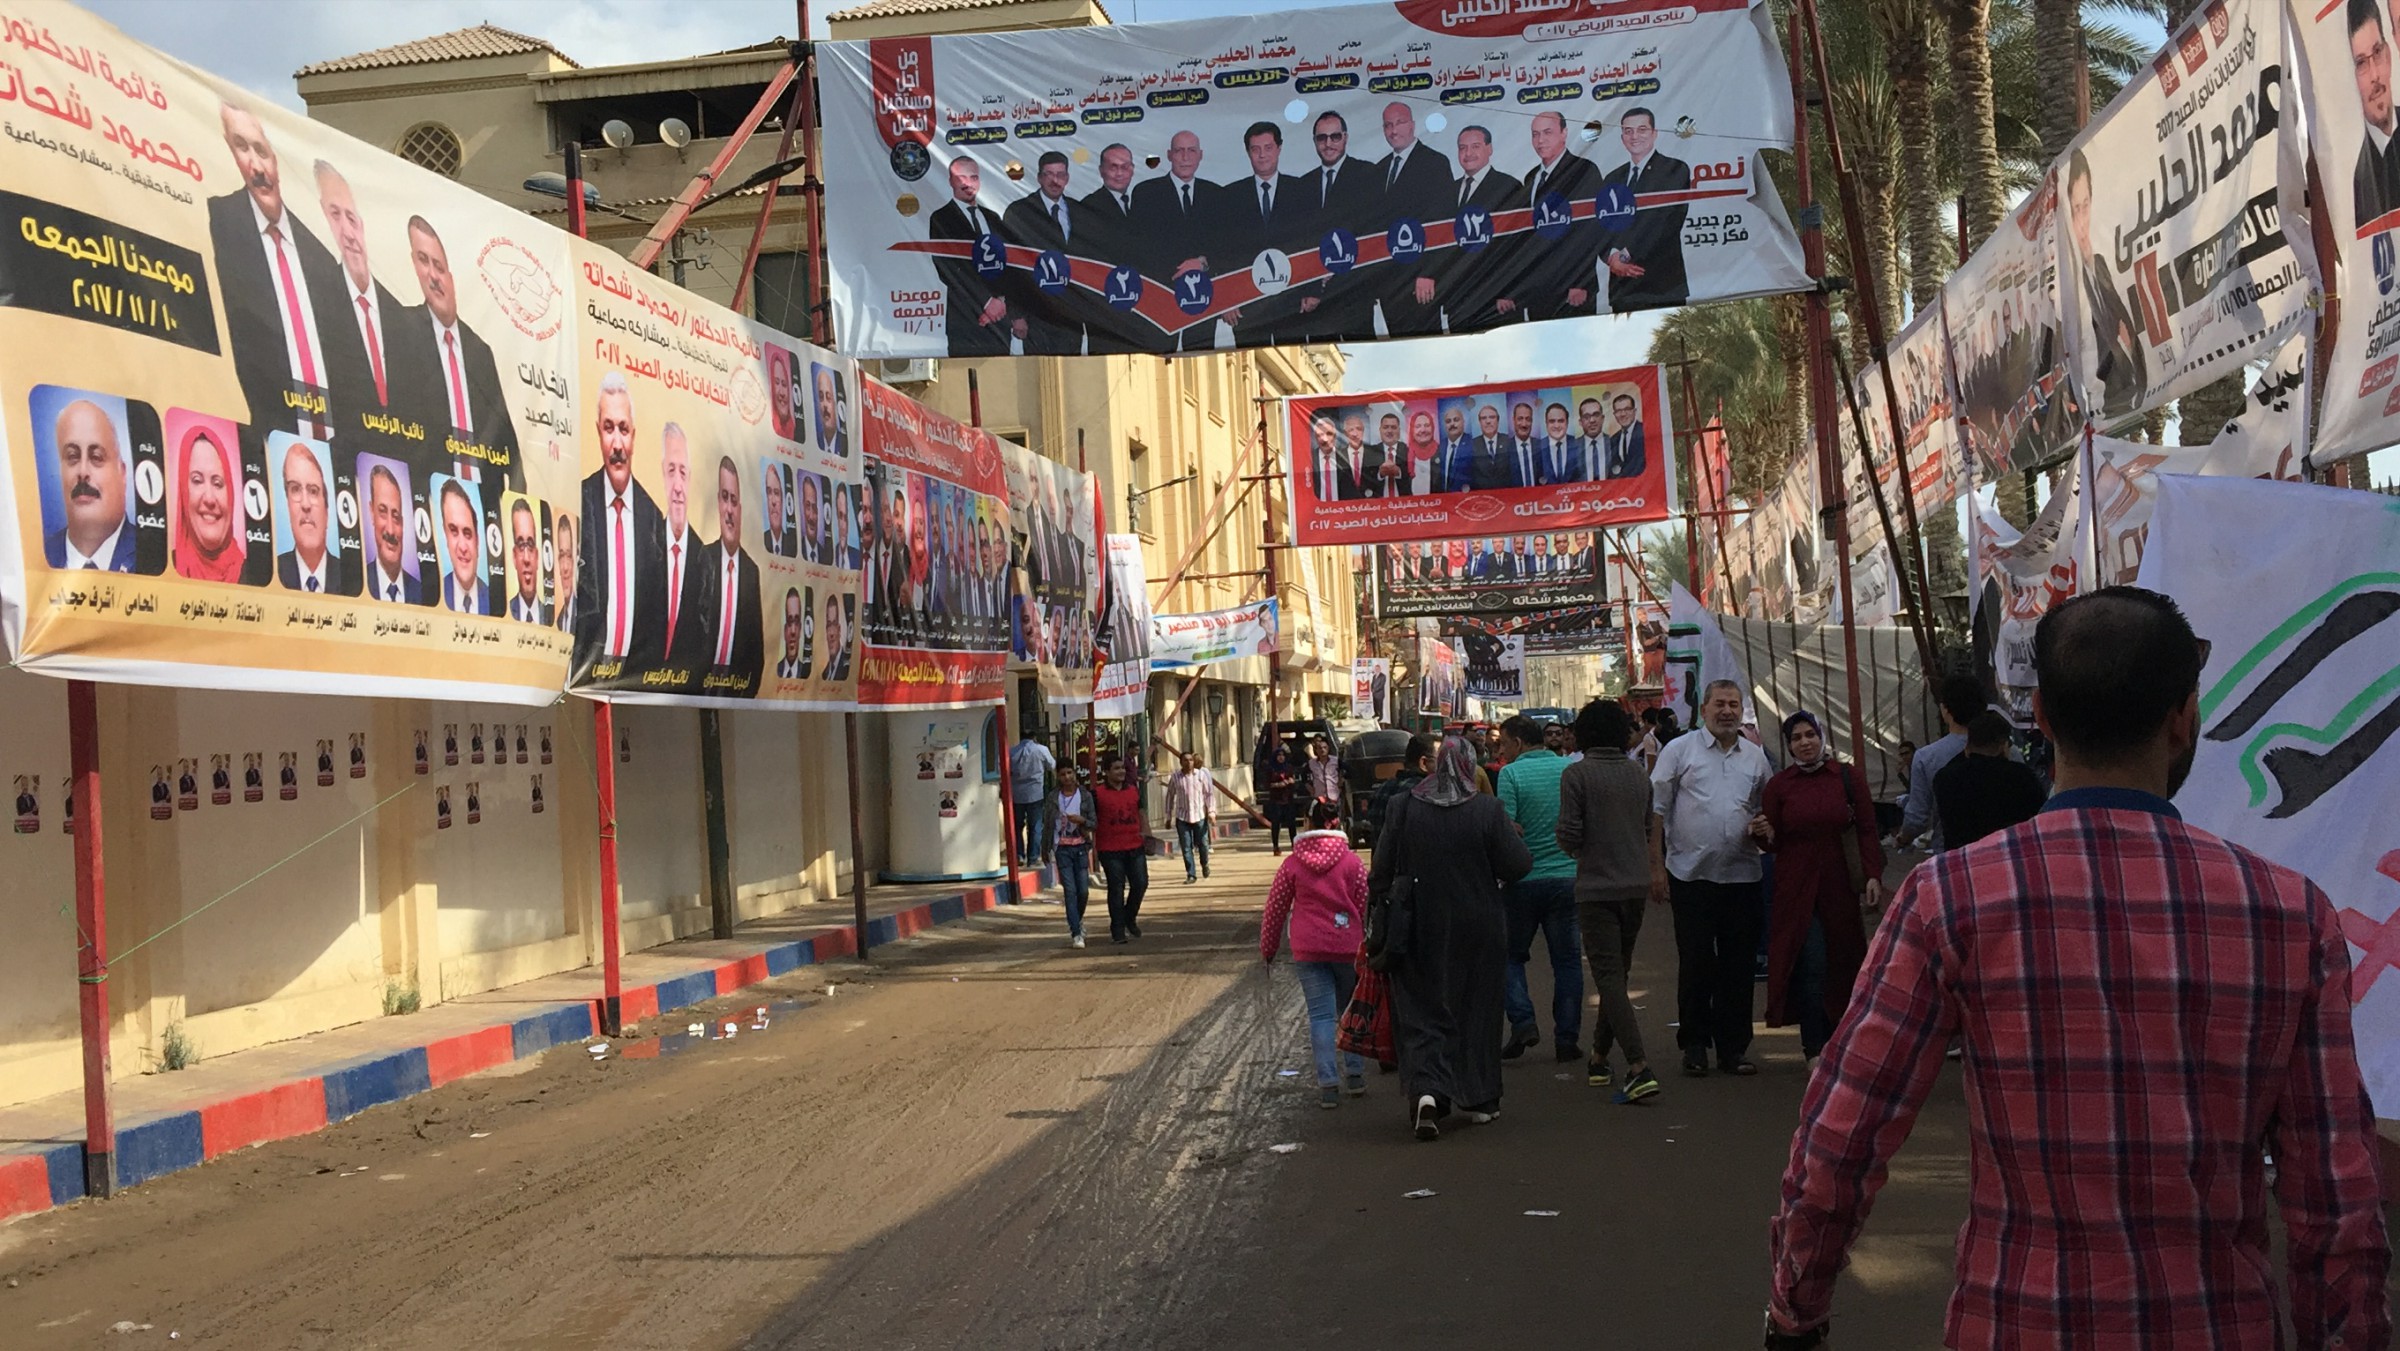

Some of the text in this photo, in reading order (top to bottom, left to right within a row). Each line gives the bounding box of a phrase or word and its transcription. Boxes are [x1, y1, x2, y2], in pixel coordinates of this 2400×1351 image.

[1537, 14, 1651, 36] الصيد ٢٠١٧
[898, 48, 918, 71] من
[1205, 44, 1296, 69] محمد الحليبى
[1290, 54, 1363, 77] محمد السبكى
[1366, 52, 1399, 78] نسيم
[1631, 53, 1662, 76] أحمد
[100, 51, 168, 111] قائمة
[896, 66, 919, 93] أجل
[1222, 69, 1282, 86] الرئيس
[1487, 62, 1512, 83] ياسر
[1551, 65, 1586, 80] مسعد
[1302, 77, 1333, 92] الرئيس
[1369, 76, 1430, 92] عضو فوق السن
[1520, 85, 1582, 103] عضو فوق السن
[1595, 81, 1658, 99] عضو تحت السن
[2197, 73, 2216, 110] نادى
[878, 91, 932, 115] مستقبل
[1152, 92, 1186, 106] الصندوق
[1444, 88, 1502, 104] عضو فوق السن
[976, 108, 1006, 121] محمد
[1043, 99, 1075, 119] مصطفى
[1083, 108, 1142, 124] عضو فوق السن
[2174, 89, 2198, 129] الصيد
[0, 60, 204, 182] محمود شحات
[892, 110, 928, 137] أفضل
[1016, 122, 1075, 137] عضو فوق السن
[2155, 110, 2176, 143] 2017
[4, 121, 58, 153] جماعية
[946, 131, 968, 143] السن
[988, 130, 1007, 141] عضو
[122, 163, 165, 194] حقيقية
[1690, 156, 1746, 189] نعم
[164, 180, 194, 205] تنمية
[2114, 122, 2208, 275] الحليبى
[1536, 215, 1571, 229] رقم
[1599, 205, 1636, 219] رقم
[1685, 213, 1742, 229] دم جديد
[1397, 223, 1414, 246] ٥
[1461, 212, 1485, 237] ١٢
[1458, 234, 1490, 247] رقم
[1684, 229, 1749, 246] فكر جديد
[20, 216, 195, 294] موعدنا الجمعه
[980, 235, 997, 263] ٤
[1391, 243, 1423, 255] رقم
[977, 261, 1004, 273] رقم
[1324, 254, 1355, 266] رقم
[582, 260, 633, 301] شحاته
[1039, 276, 1069, 288] رقم
[1115, 269, 1130, 295] ٢
[1184, 273, 1202, 299] ٣
[1258, 274, 1289, 285] رقم
[2245, 263, 2294, 303] الجمعة
[890, 289, 942, 303] موعدنا
[1108, 293, 1139, 305] رقم
[1179, 295, 1211, 308] رقم
[587, 298, 627, 331] جماعية
[636, 286, 680, 328] محمود
[893, 303, 945, 320] الجمعه
[2367, 301, 2400, 338] صطفى
[689, 315, 731, 347] الدكتور
[731, 327, 762, 362] قائمة
[624, 353, 661, 382] الصيد
[662, 366, 690, 391] نادى
[283, 388, 327, 414] الرئيس
[361, 411, 425, 442] نائب الرئيس
[444, 434, 487, 461] الصندوق
[1513, 495, 1646, 516] محمود شحاته
[136, 514, 166, 530] عضو
[1309, 511, 1448, 531] إنتخابات نادى الصيد ٢٠١٧
[246, 528, 271, 544] عضو
[339, 535, 361, 551] عضو
[417, 550, 437, 564] عضو
[1512, 591, 1595, 606] محمود شحاته
[591, 662, 623, 679] الرئيس
[642, 667, 671, 686] الرئيس
